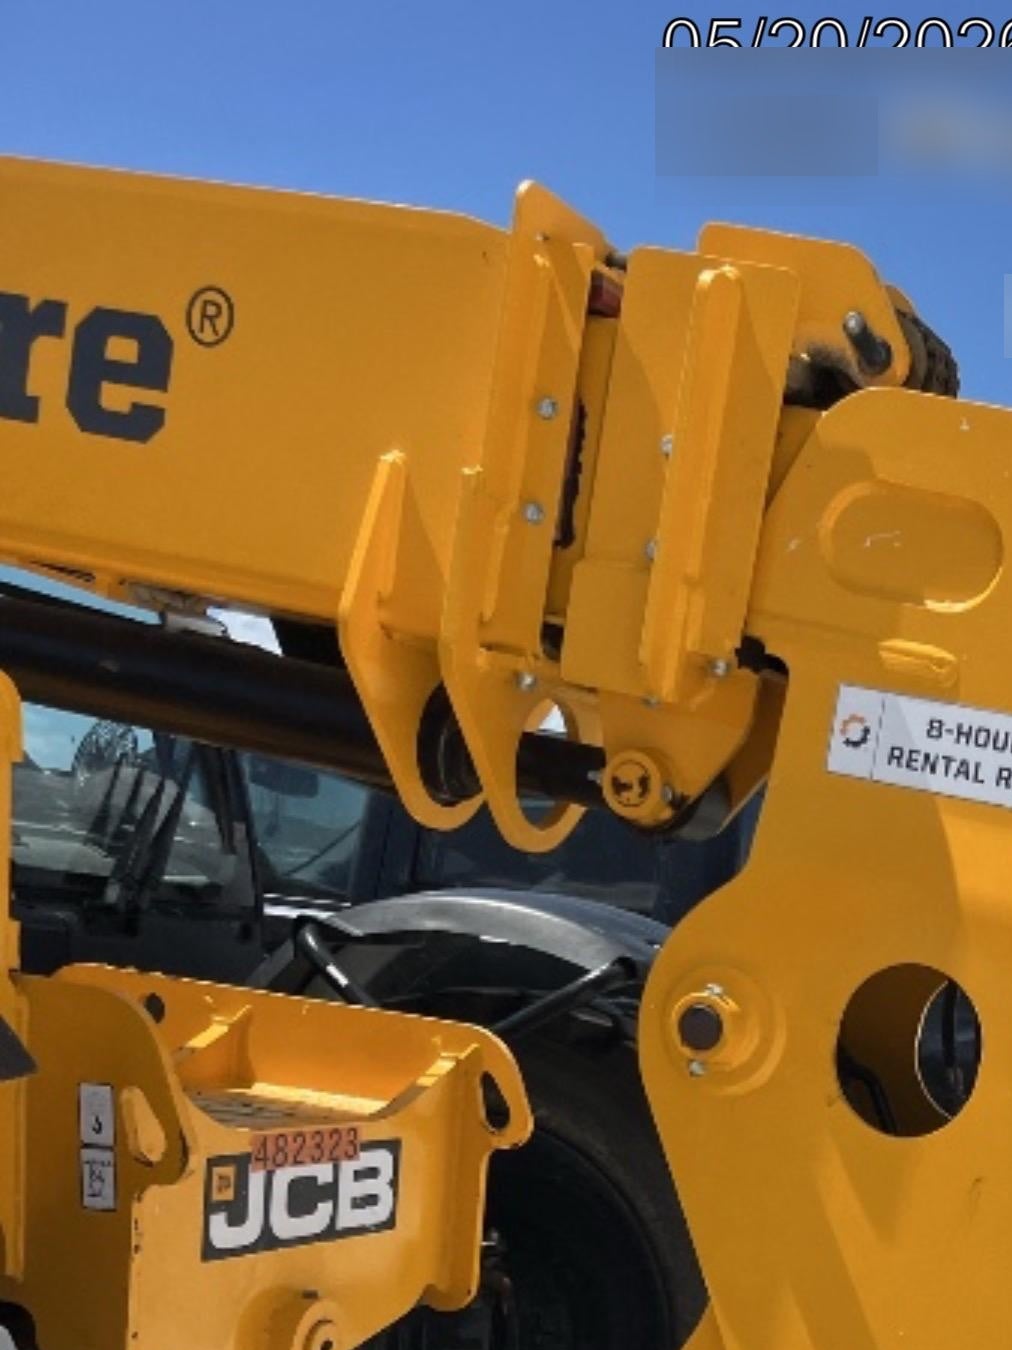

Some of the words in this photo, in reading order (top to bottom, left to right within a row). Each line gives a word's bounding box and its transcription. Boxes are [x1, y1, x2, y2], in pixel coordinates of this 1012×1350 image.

[887, 746, 985, 784] RENTAL
[254, 1127, 359, 1169] 482323
[208, 1149, 394, 1249] JCB
